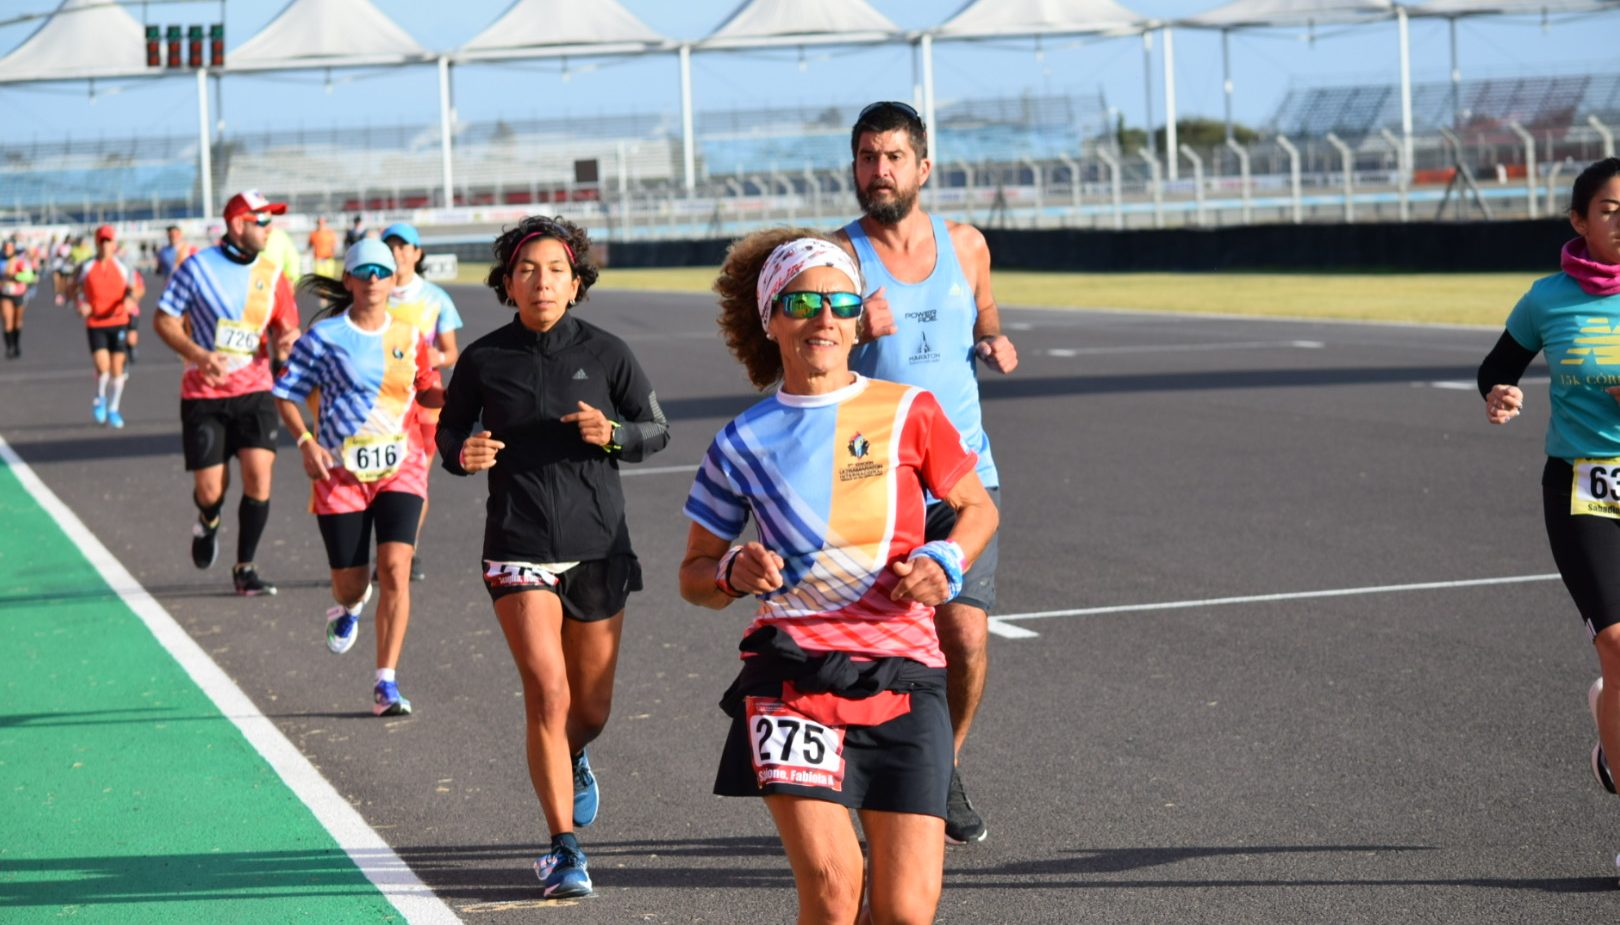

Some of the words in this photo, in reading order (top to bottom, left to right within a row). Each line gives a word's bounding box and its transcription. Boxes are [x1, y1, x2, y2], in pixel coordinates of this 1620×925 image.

[224, 328, 258, 351] 726
[356, 444, 397, 469] 616
[1590, 466, 1620, 502] 63
[756, 717, 826, 765] 275
